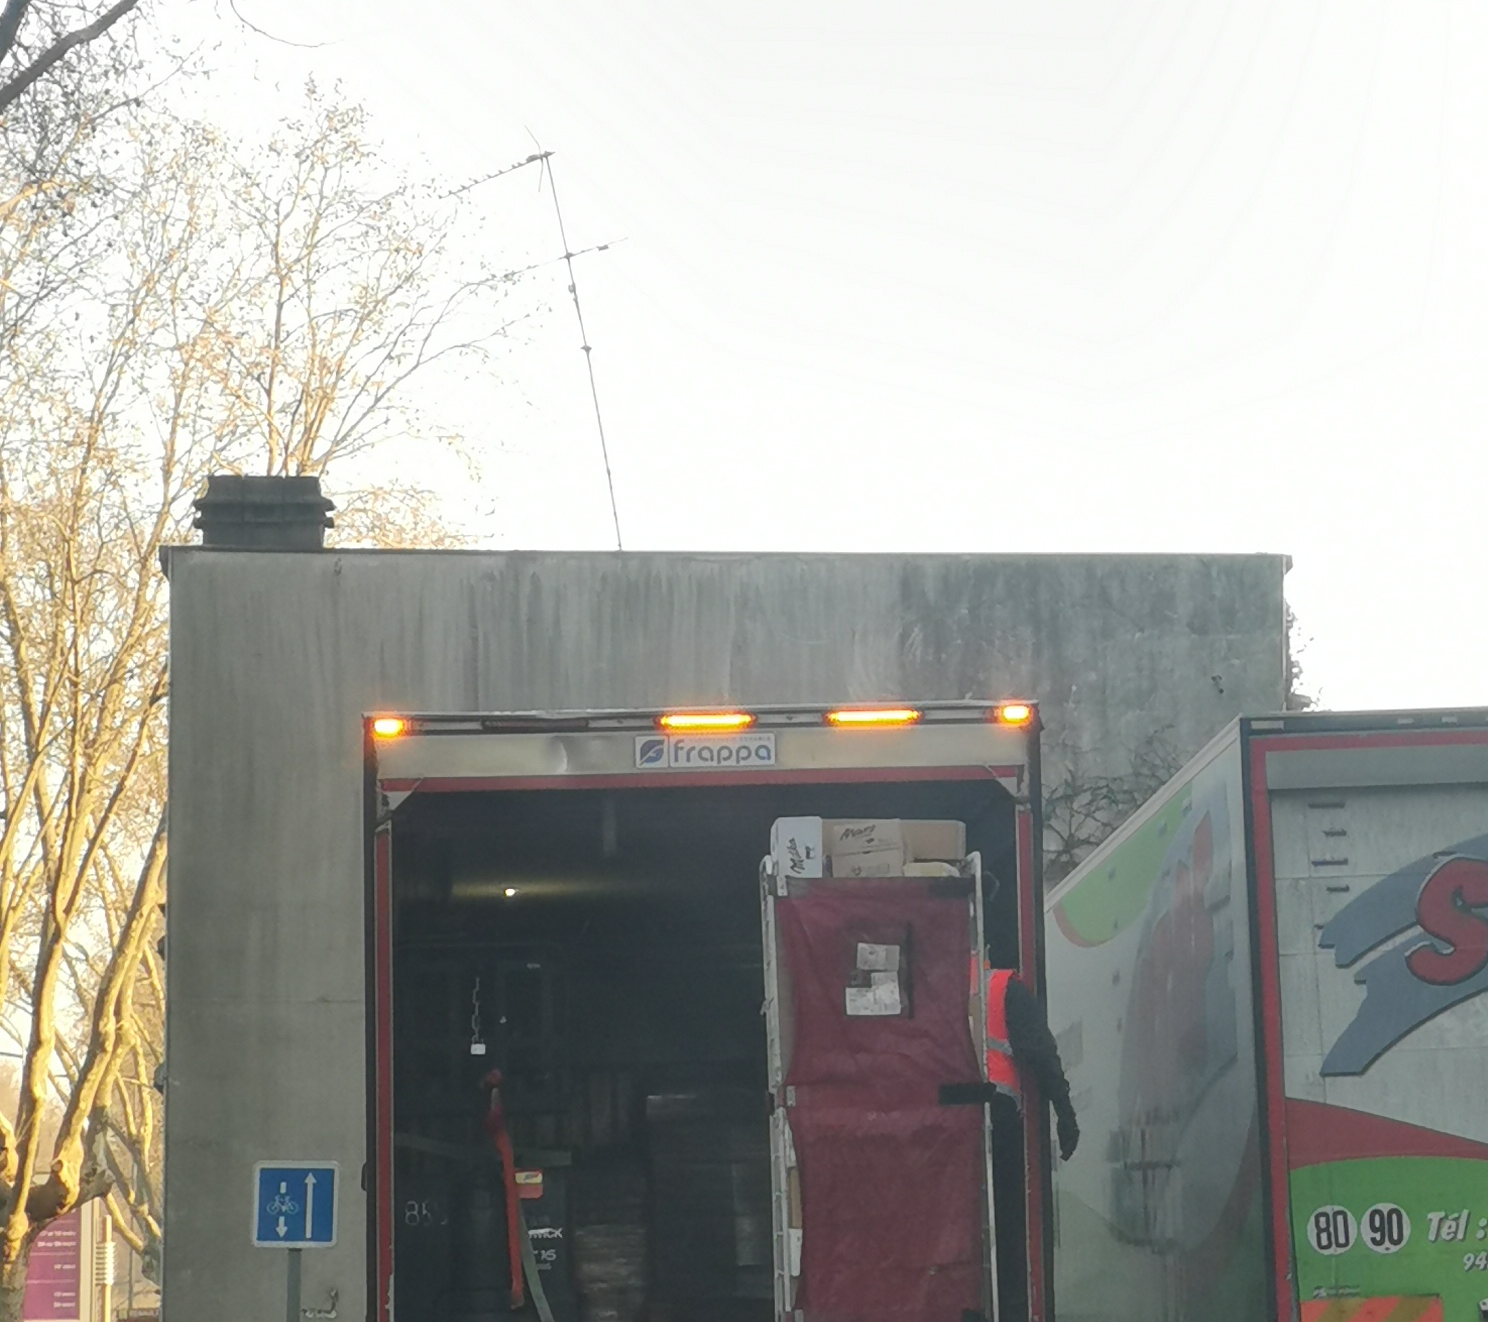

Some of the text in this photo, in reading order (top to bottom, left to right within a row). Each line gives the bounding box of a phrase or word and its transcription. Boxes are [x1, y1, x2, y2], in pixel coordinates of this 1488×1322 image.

[673, 739, 772, 764] frappa
[1314, 1210, 1350, 1250] 80
[1369, 1207, 1404, 1246] 90
